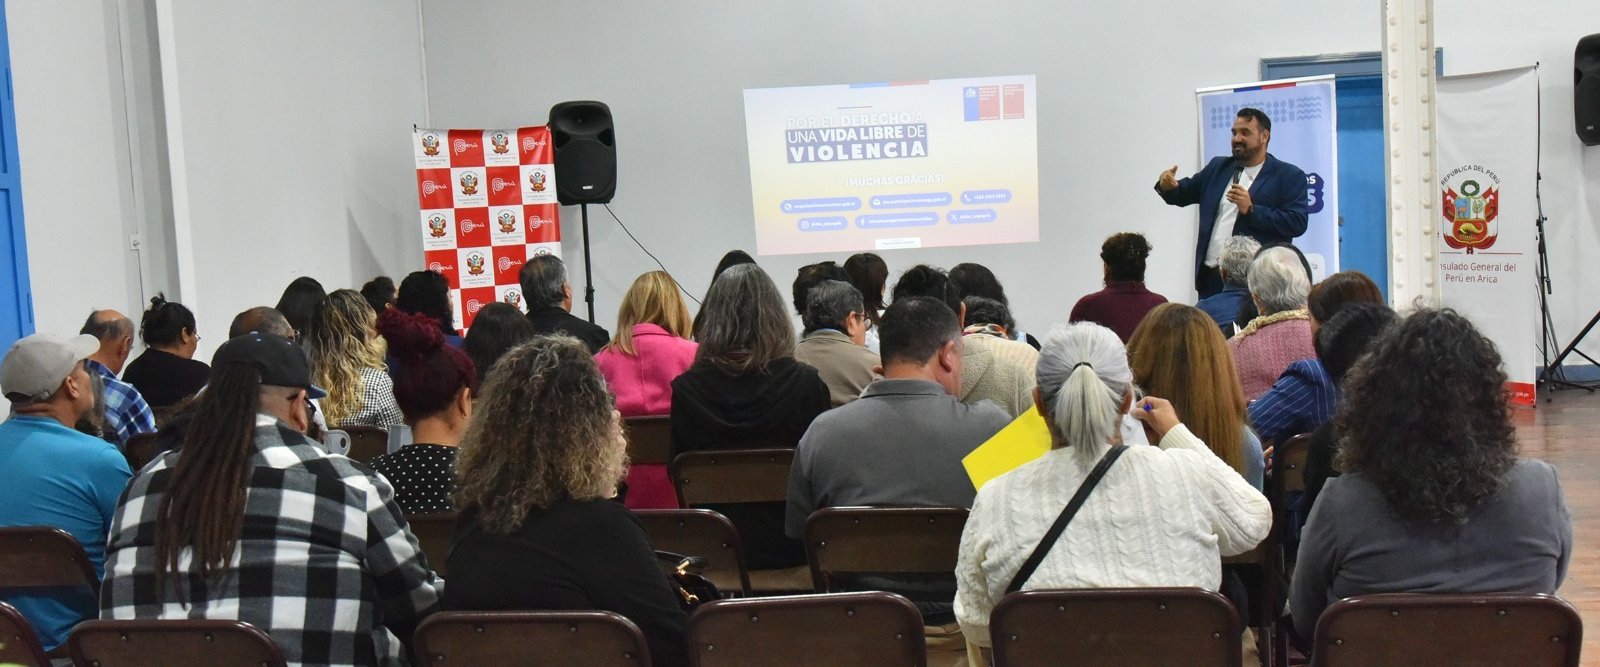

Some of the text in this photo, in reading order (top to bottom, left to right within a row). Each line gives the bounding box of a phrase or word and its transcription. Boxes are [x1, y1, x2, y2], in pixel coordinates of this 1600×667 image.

[787, 111, 925, 130] POR EL DERECHO A
[788, 125, 926, 144] UNA VIDA LIBRE DE
[789, 140, 926, 162] VIOLENCIA
[1473, 164, 1485, 173] DEL
[1470, 262, 1502, 272] General
[1503, 262, 1517, 272] del
[1445, 273, 1498, 284] Perú en Arica
